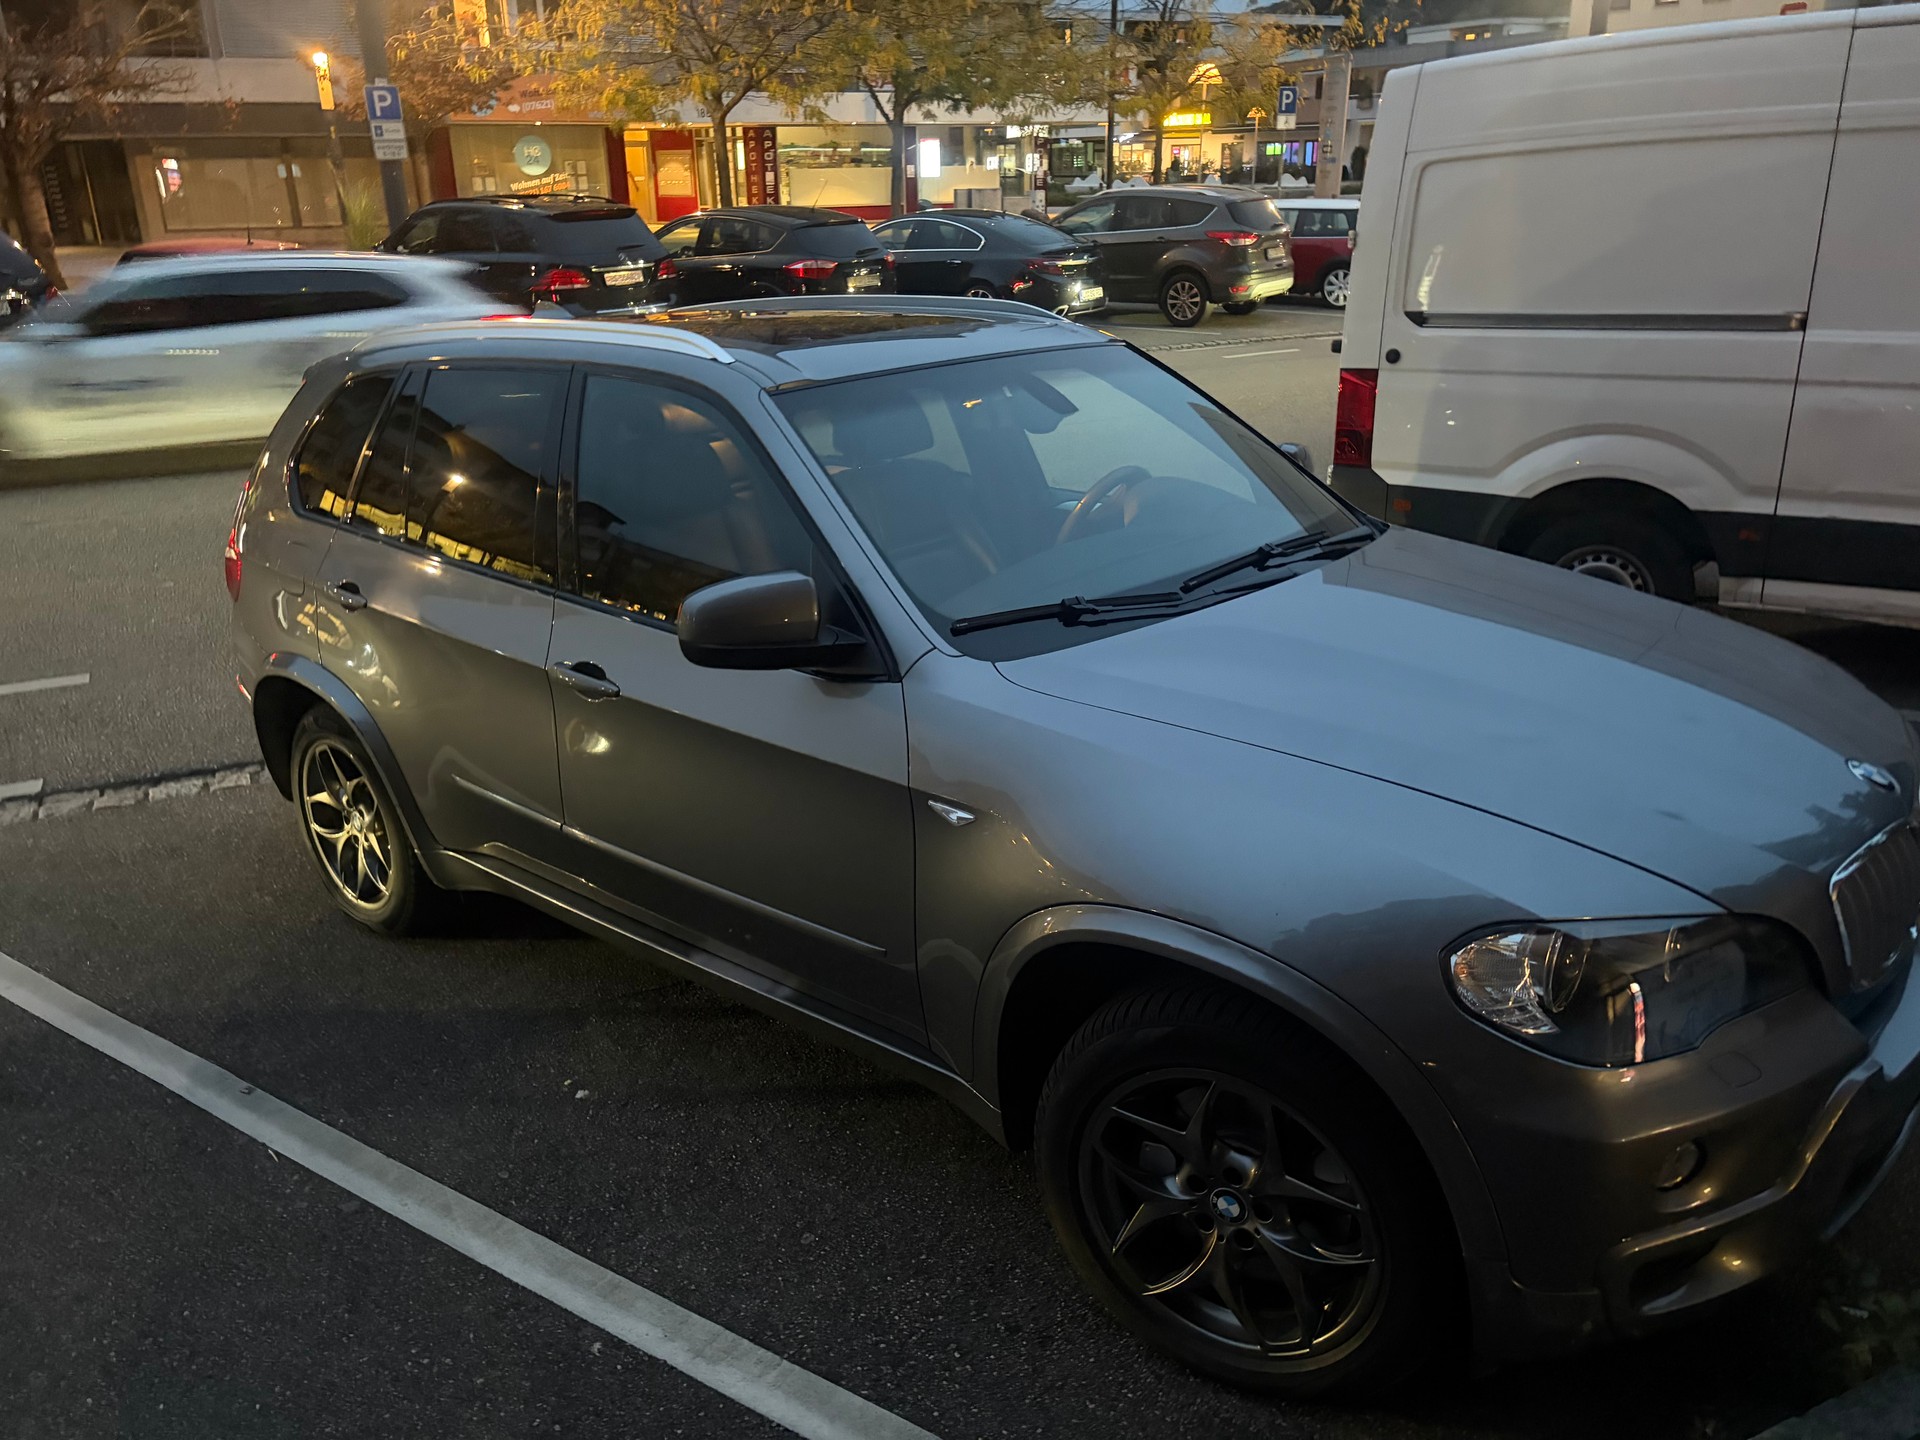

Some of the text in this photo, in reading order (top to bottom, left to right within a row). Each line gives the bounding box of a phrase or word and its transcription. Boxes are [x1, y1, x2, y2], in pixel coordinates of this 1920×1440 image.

[373, 90, 392, 117] P
[1282, 91, 1294, 111] P
[763, 130, 775, 204] APOTEK
[510, 179, 540, 191] Wohnen
[541, 173, 554, 184] auf
